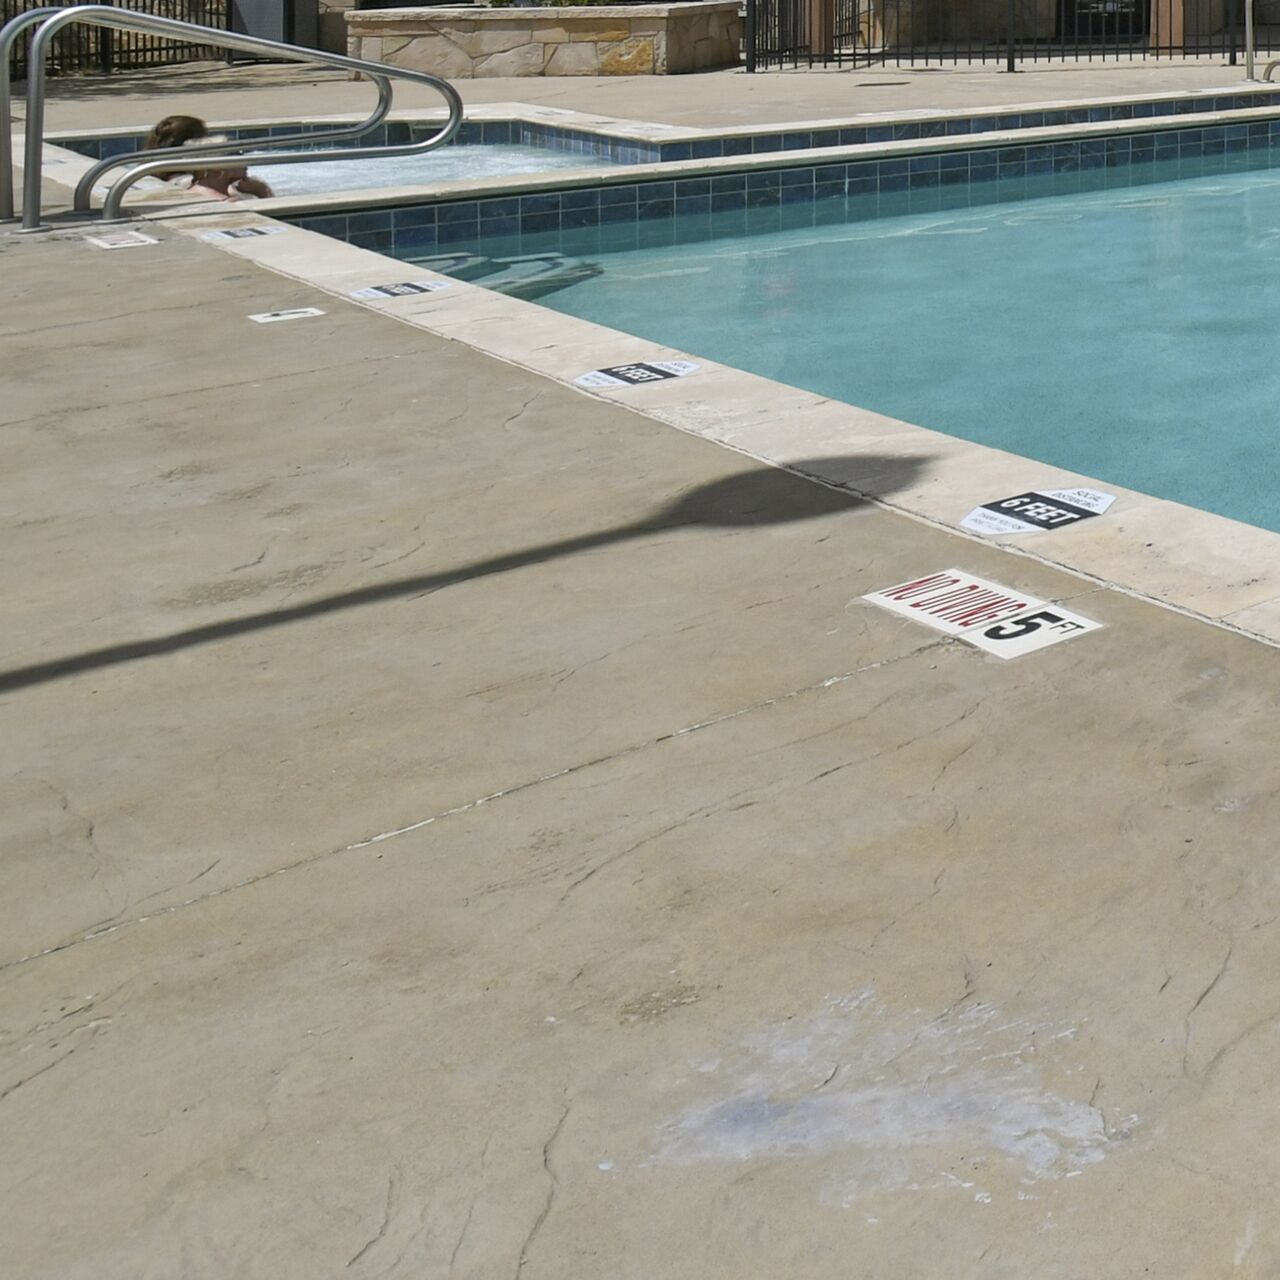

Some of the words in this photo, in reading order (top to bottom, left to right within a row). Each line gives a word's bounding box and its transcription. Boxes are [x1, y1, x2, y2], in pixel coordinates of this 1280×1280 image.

[1000, 497, 1031, 508] 6
[1013, 502, 1081, 523] FEET
[879, 573, 961, 601] NO
[909, 584, 1027, 627] DIVING
[984, 611, 1066, 640] 5
[1049, 621, 1086, 634] FT
